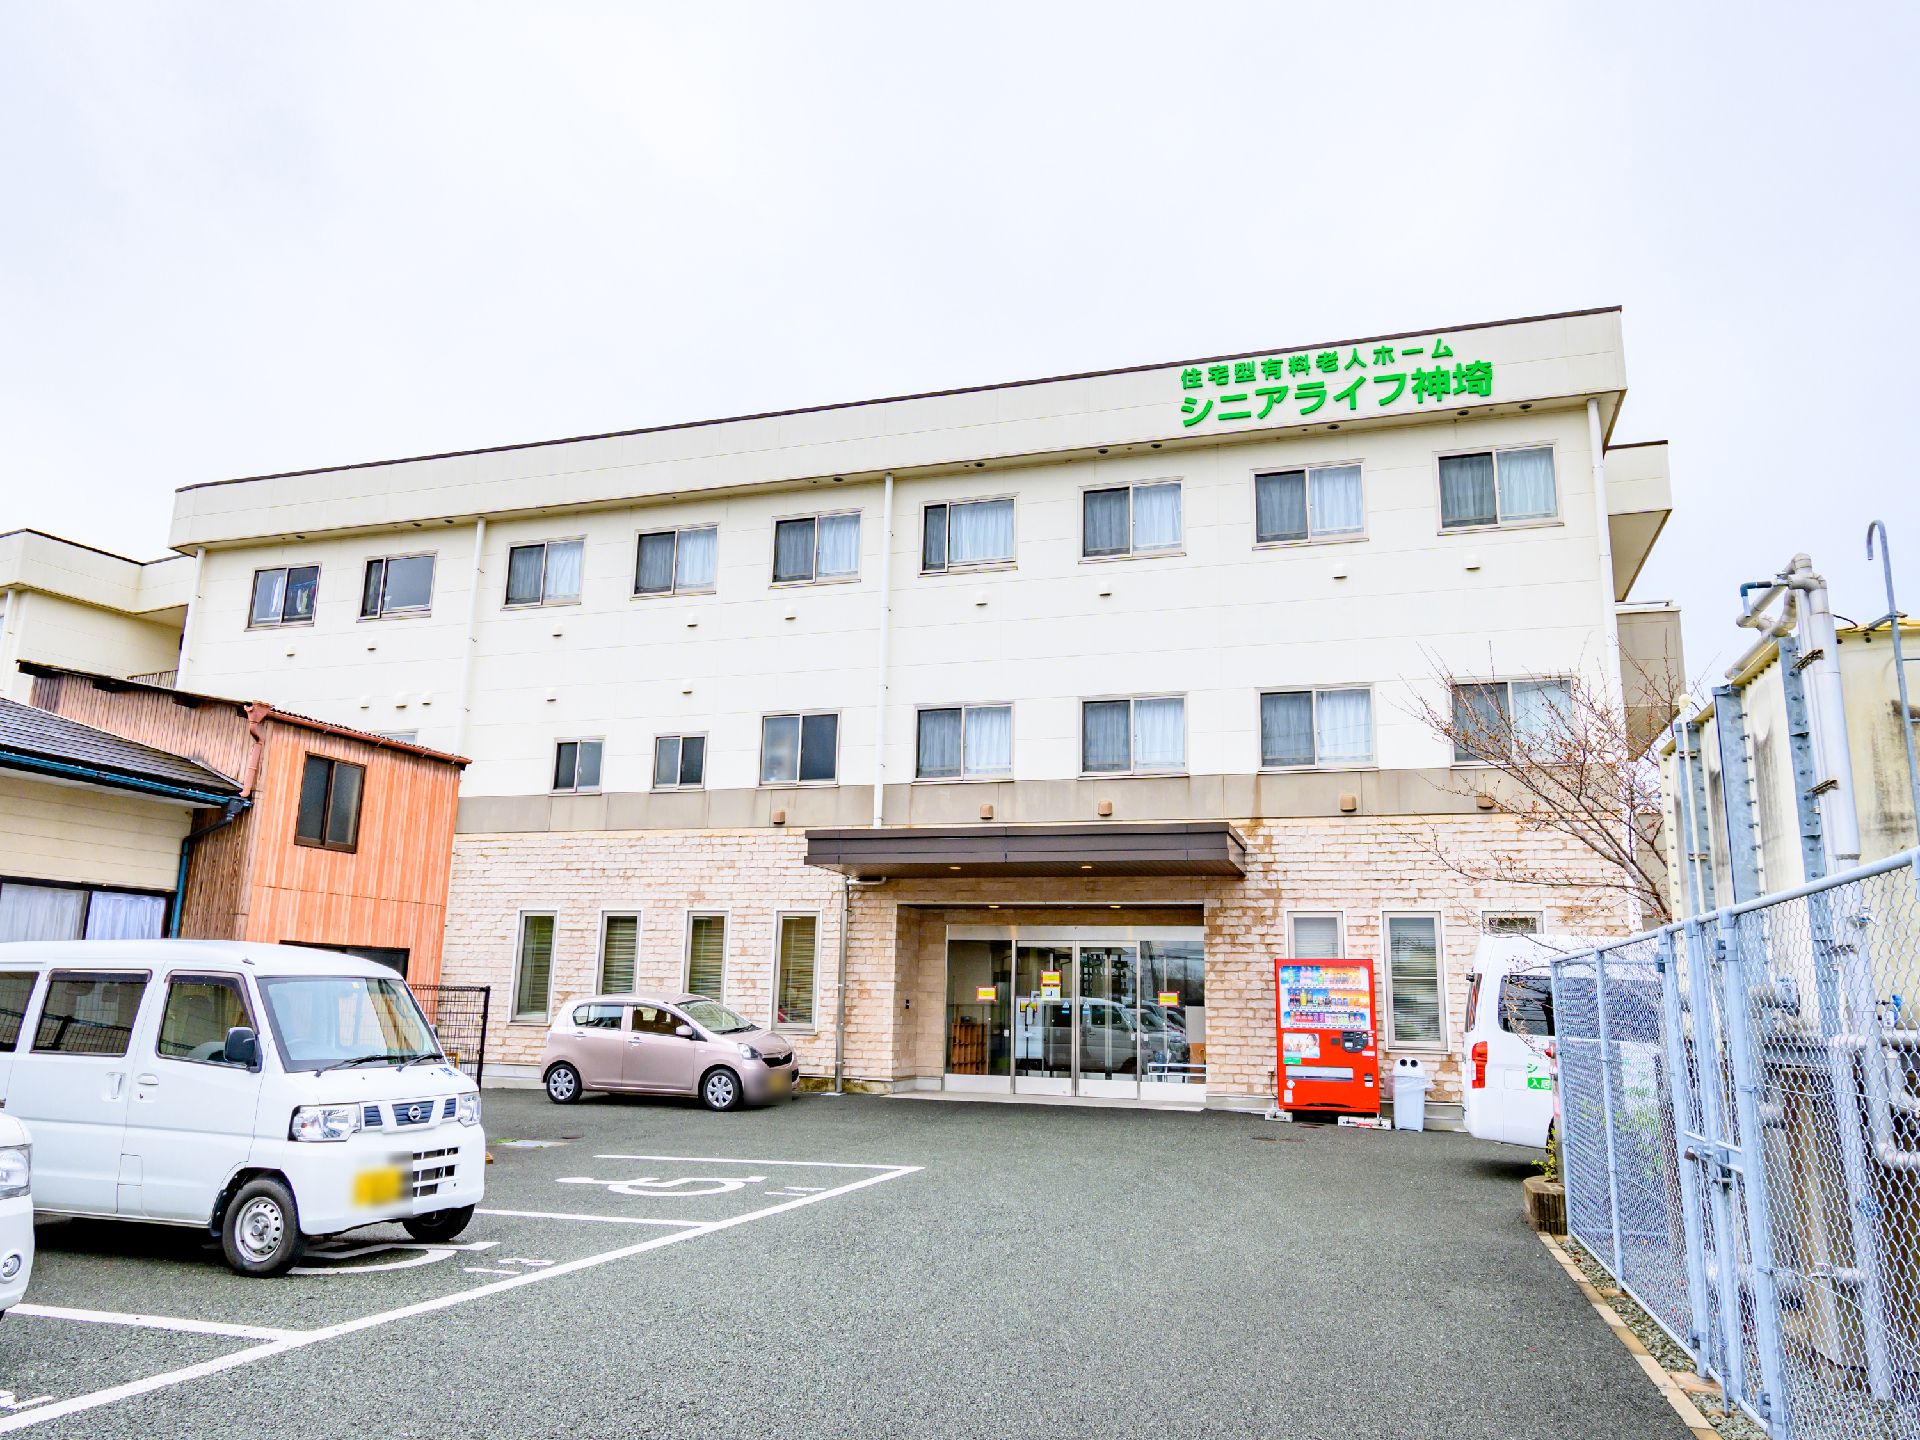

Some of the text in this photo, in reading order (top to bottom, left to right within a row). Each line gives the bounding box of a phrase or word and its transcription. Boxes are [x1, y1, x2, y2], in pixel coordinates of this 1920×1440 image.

[1180, 338, 1454, 390] 住宅型有料老人ホーム
[1180, 359, 1493, 428] シニアライフ神埼
